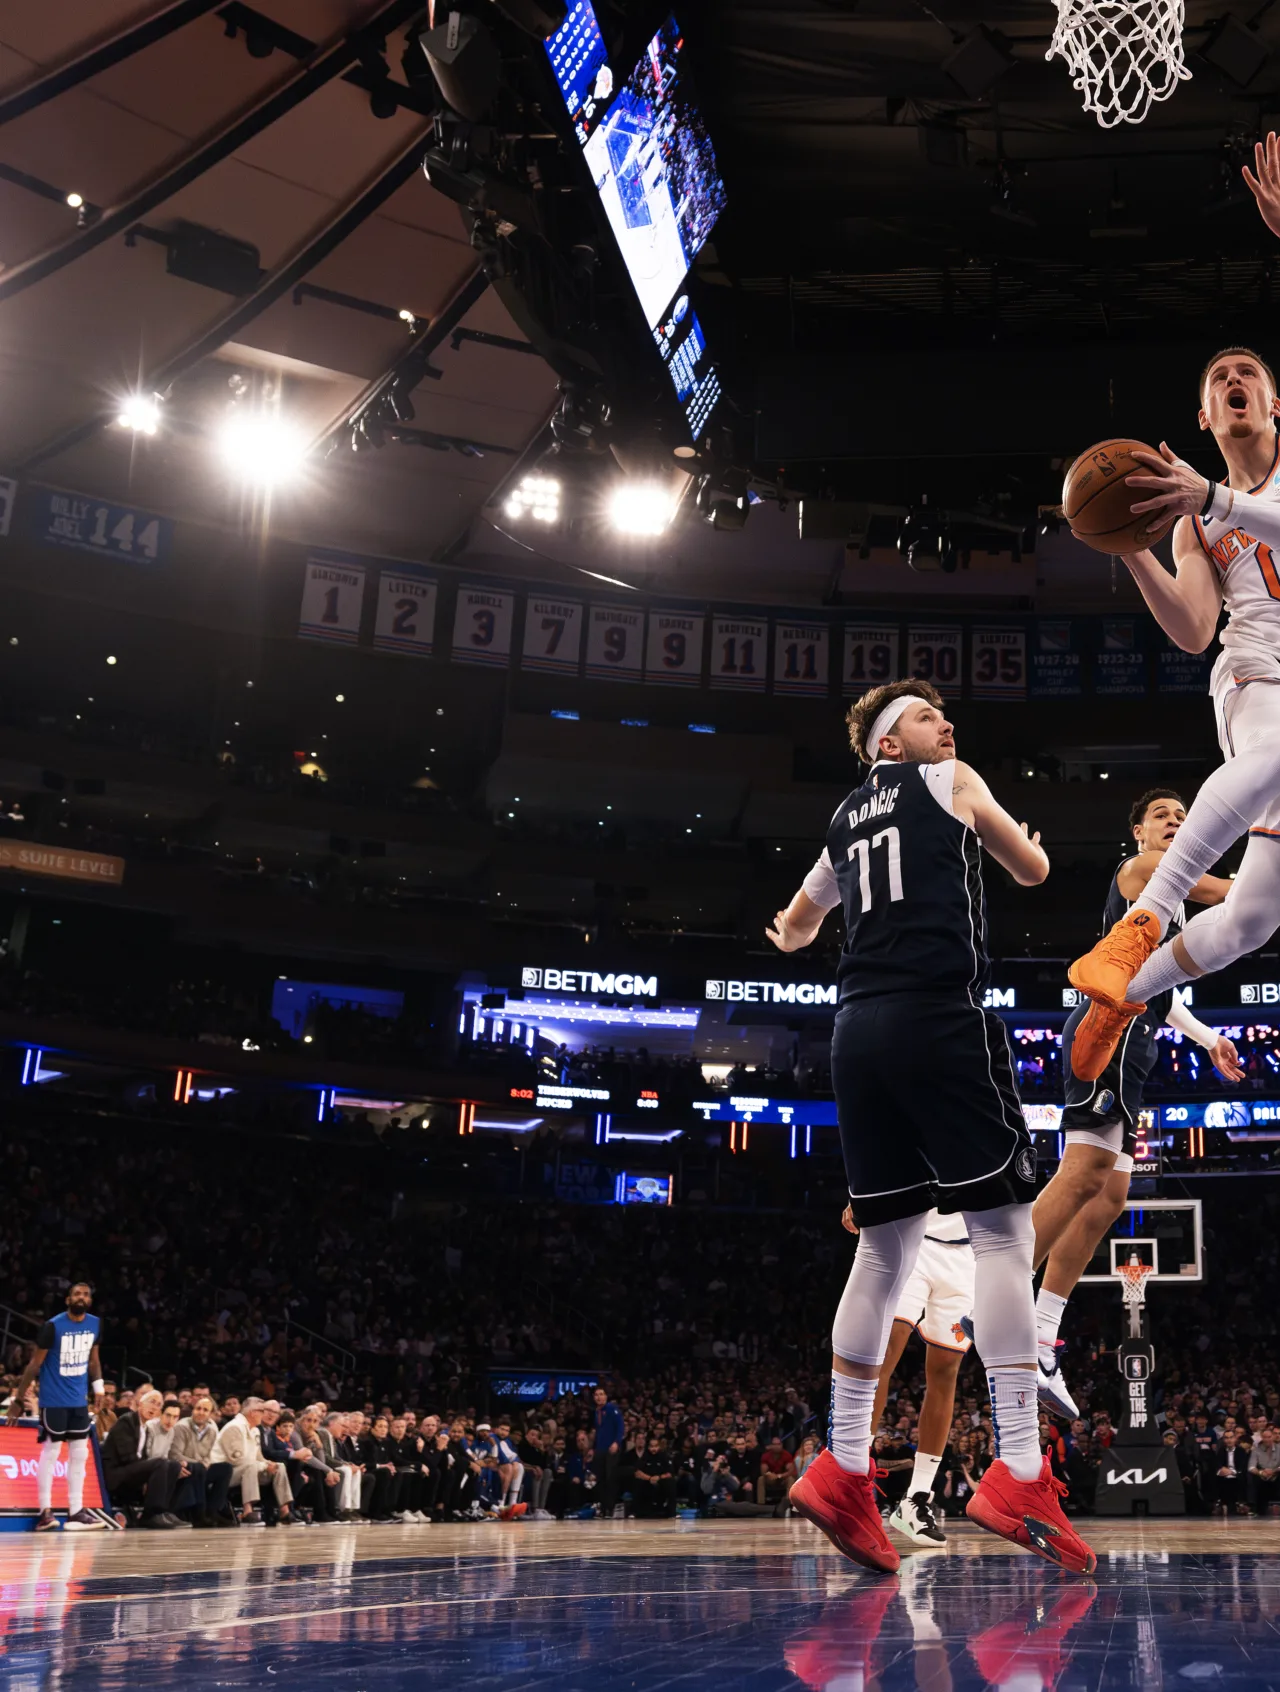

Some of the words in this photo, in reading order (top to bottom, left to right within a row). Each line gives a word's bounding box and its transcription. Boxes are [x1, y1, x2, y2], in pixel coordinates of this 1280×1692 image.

[582, 94, 596, 118] 16
[90, 508, 159, 558] 144
[321, 586, 339, 624] 1
[392, 598, 418, 636] 2
[471, 609, 495, 647] 3
[541, 618, 566, 655] 7
[604, 626, 626, 662] 9
[663, 633, 686, 669] 9
[721, 637, 755, 674] 11
[784, 643, 818, 680] 11
[851, 644, 890, 680] 19
[912, 646, 956, 681] 30
[976, 648, 1022, 682] 35
[848, 783, 901, 829] DONČIĆ
[19, 850, 66, 868] SUITE
[70, 858, 116, 876] LEVEL
[847, 826, 904, 913] 77
[544, 969, 658, 996] BETMGM
[728, 981, 838, 1004] BETMGM
[510, 1088, 533, 1098] 8:02
[641, 1090, 658, 1098] NBA
[704, 1109, 711, 1120] 1
[1166, 1108, 1188, 1120] 20
[1131, 1163, 1158, 1172] SSOT
[1129, 1382, 1146, 1396] GET
[1130, 1398, 1146, 1412] THE
[1130, 1413, 1148, 1428] APP
[1107, 1468, 1167, 1484] KIA
